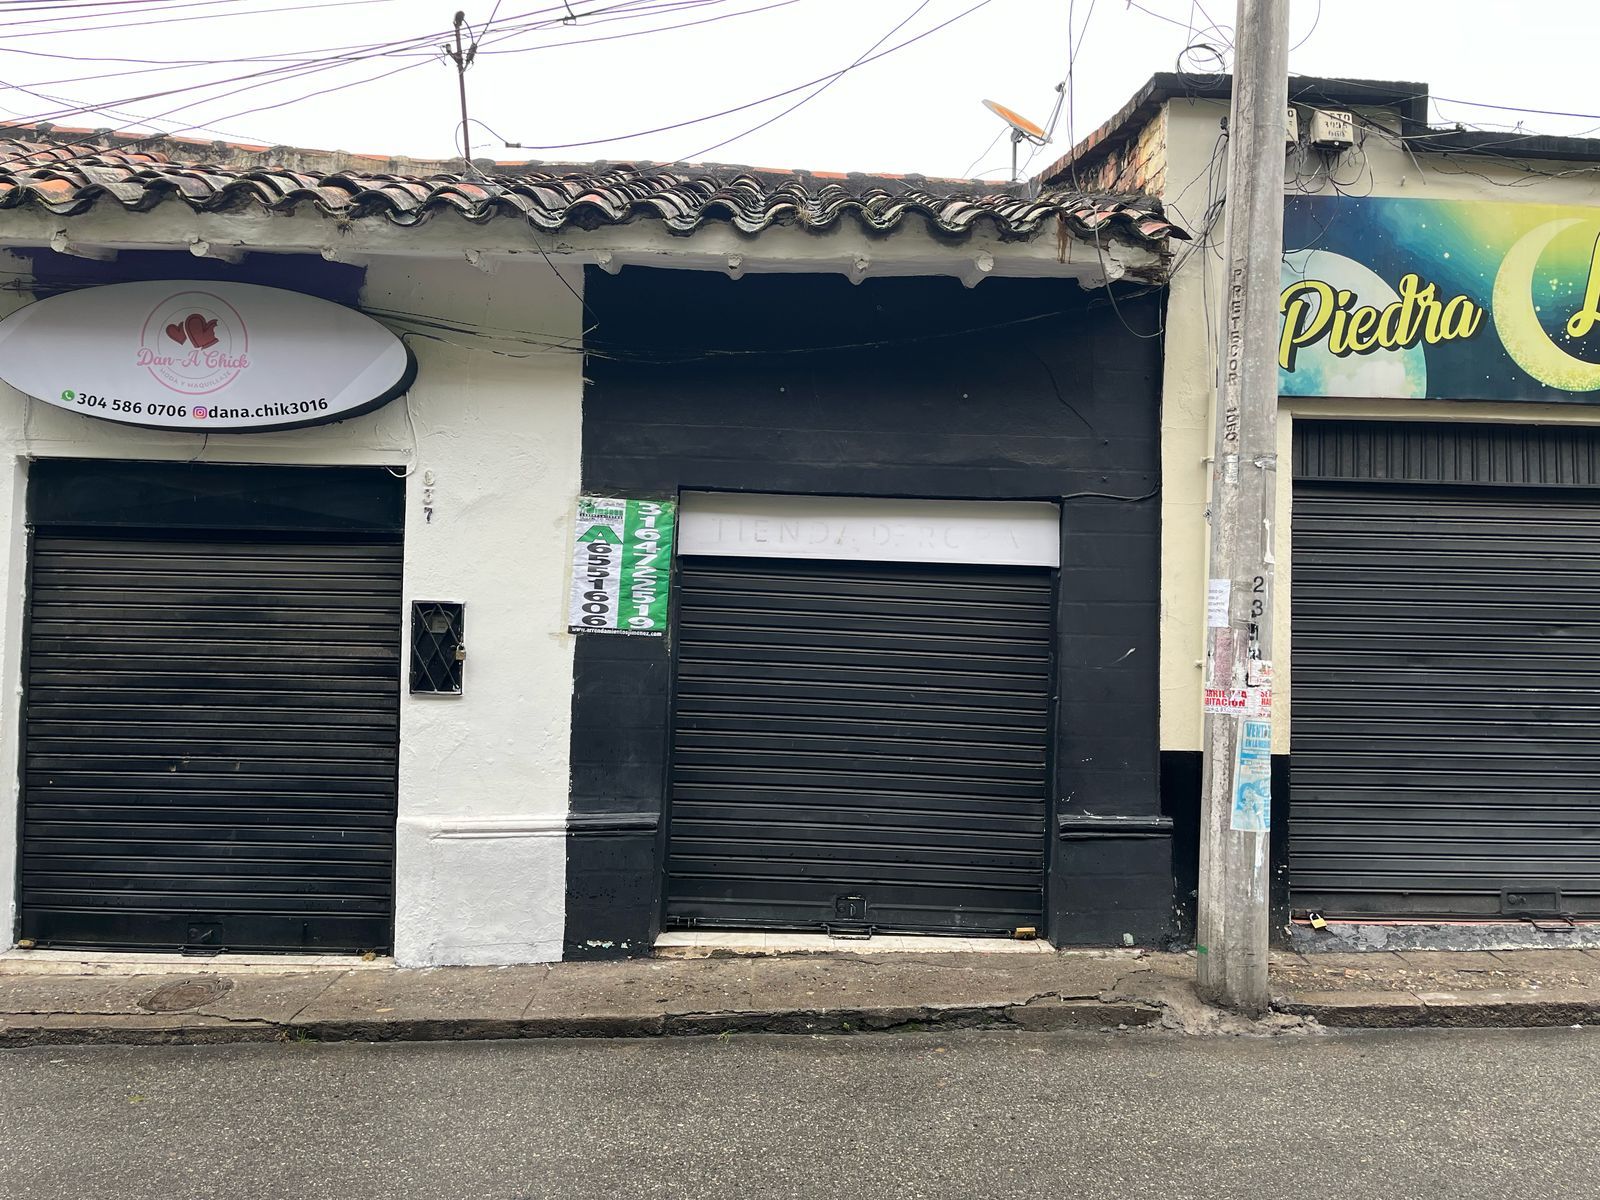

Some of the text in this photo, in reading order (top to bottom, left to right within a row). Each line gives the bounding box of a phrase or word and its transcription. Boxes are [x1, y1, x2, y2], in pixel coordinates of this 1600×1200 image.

[1278, 273, 1485, 372] Piedra
[202, 350, 250, 369] Chick
[160, 367, 179, 385] MODA
[187, 370, 232, 389] MAQUILLAJE
[76, 393, 328, 419] 304 586 0706 dana.chik3016
